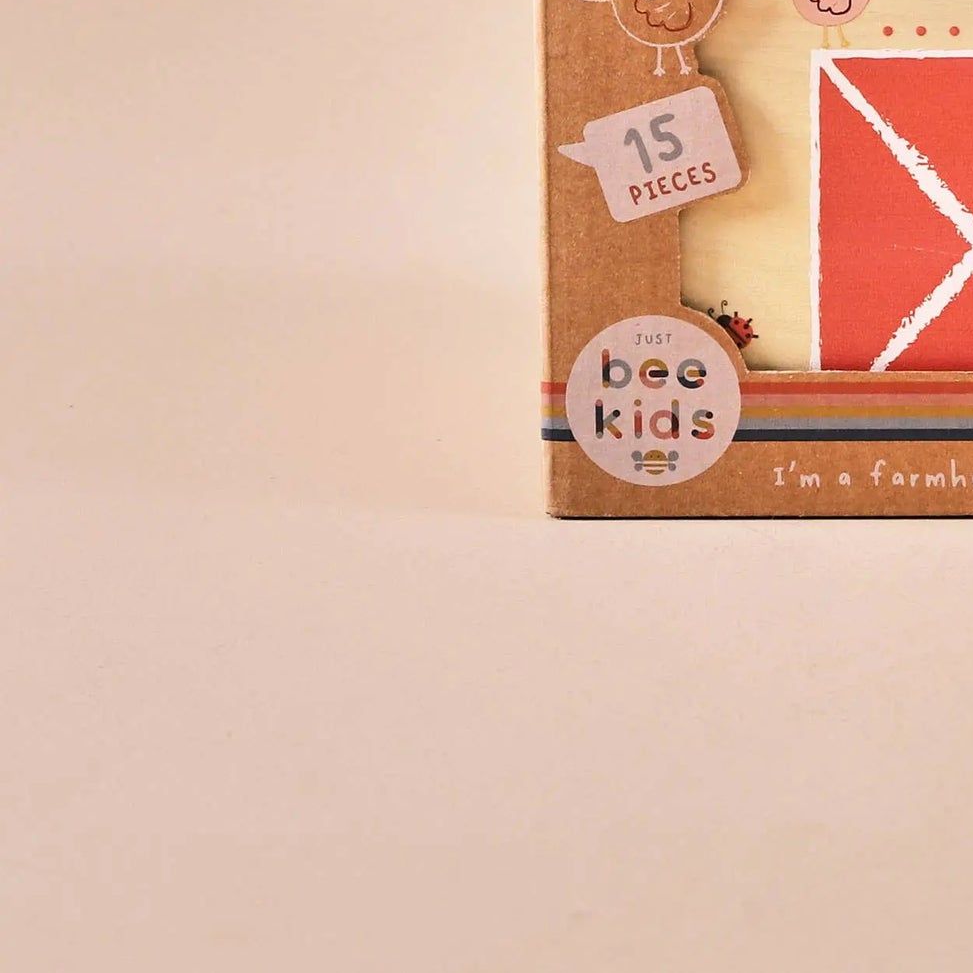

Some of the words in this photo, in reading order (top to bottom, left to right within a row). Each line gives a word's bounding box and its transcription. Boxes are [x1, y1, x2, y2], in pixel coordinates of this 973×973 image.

[623, 113, 684, 174] 15
[628, 161, 718, 206] PIECES
[634, 333, 673, 346] JUST
[601, 348, 708, 389] bee
[595, 399, 716, 440] kids
[772, 460, 821, 488] I'm
[837, 471, 851, 487] a
